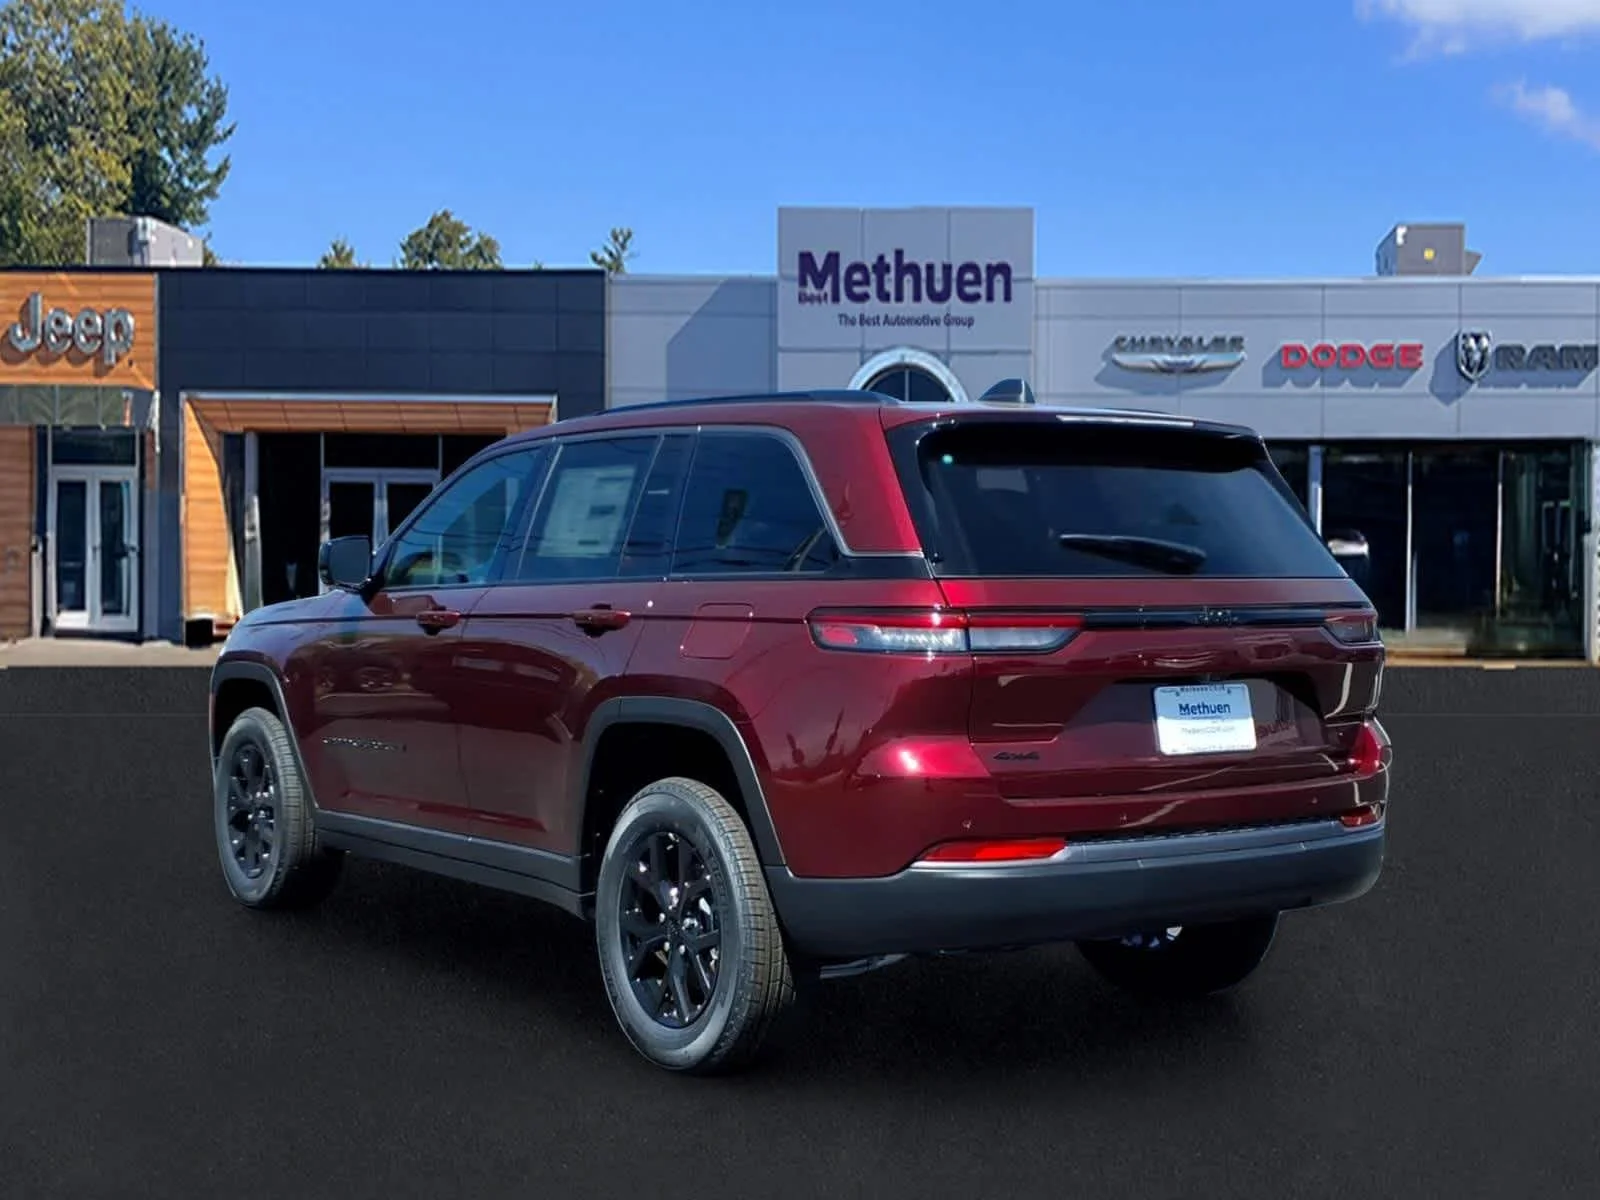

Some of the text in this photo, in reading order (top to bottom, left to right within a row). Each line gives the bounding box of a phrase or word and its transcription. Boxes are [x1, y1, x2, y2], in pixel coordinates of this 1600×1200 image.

[797, 249, 1012, 304] Methuen
[9, 292, 135, 365] Jeep
[838, 313, 975, 328] The Best Automotive Group
[1113, 335, 1245, 352] CHRYSLER
[1281, 343, 1424, 369] DODGE
[1495, 344, 1599, 370] RAM
[1179, 703, 1231, 716] Methuen
